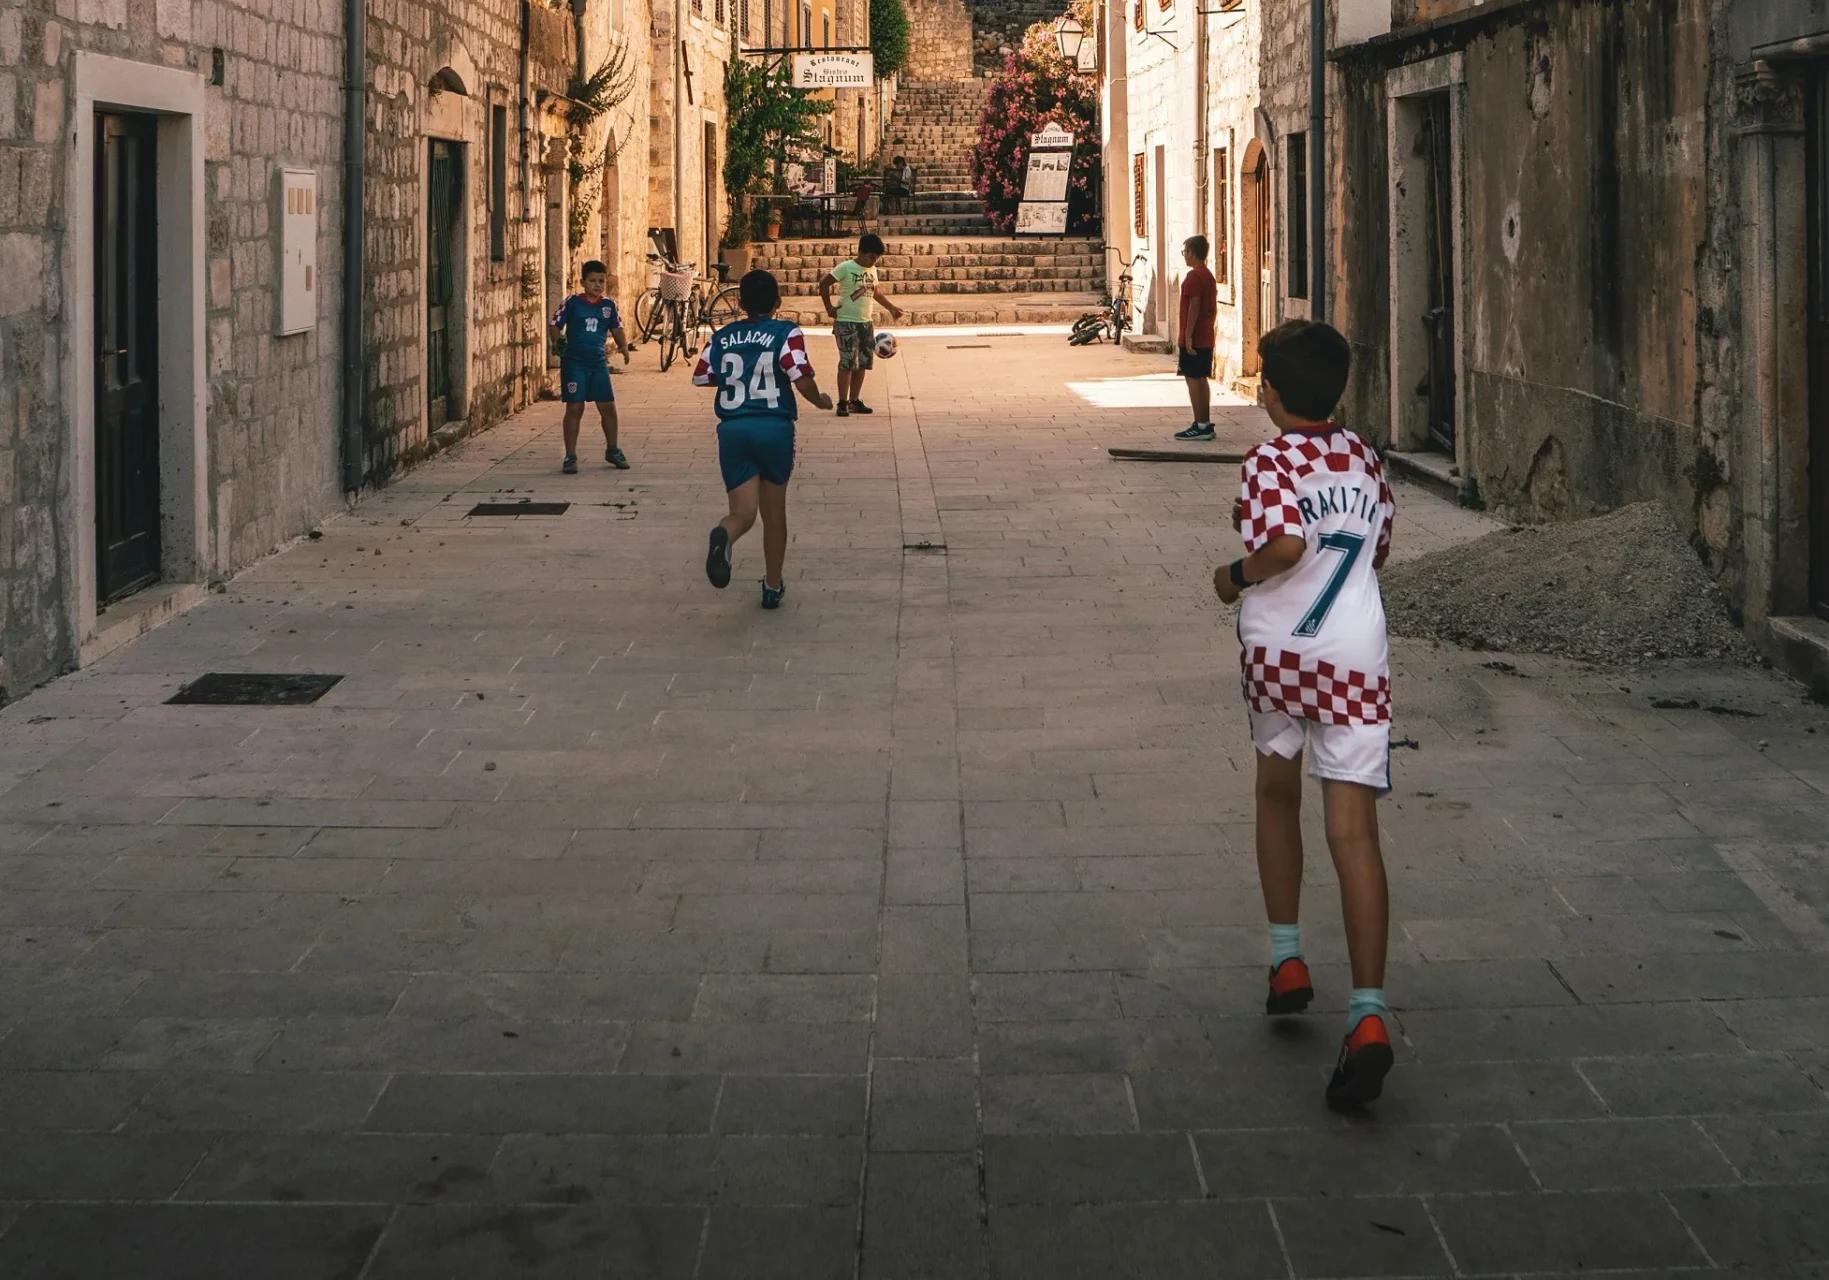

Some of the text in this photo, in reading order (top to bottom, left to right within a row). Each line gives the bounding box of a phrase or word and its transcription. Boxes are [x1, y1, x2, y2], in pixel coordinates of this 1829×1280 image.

[810, 55, 859, 67] Restaurant
[803, 69, 864, 85] Stagnum
[1034, 133, 1069, 146] Stagnum
[585, 317, 598, 333] 10
[720, 330, 775, 349] SALACAN
[720, 351, 780, 410] 34
[1291, 529, 1366, 638] 7
